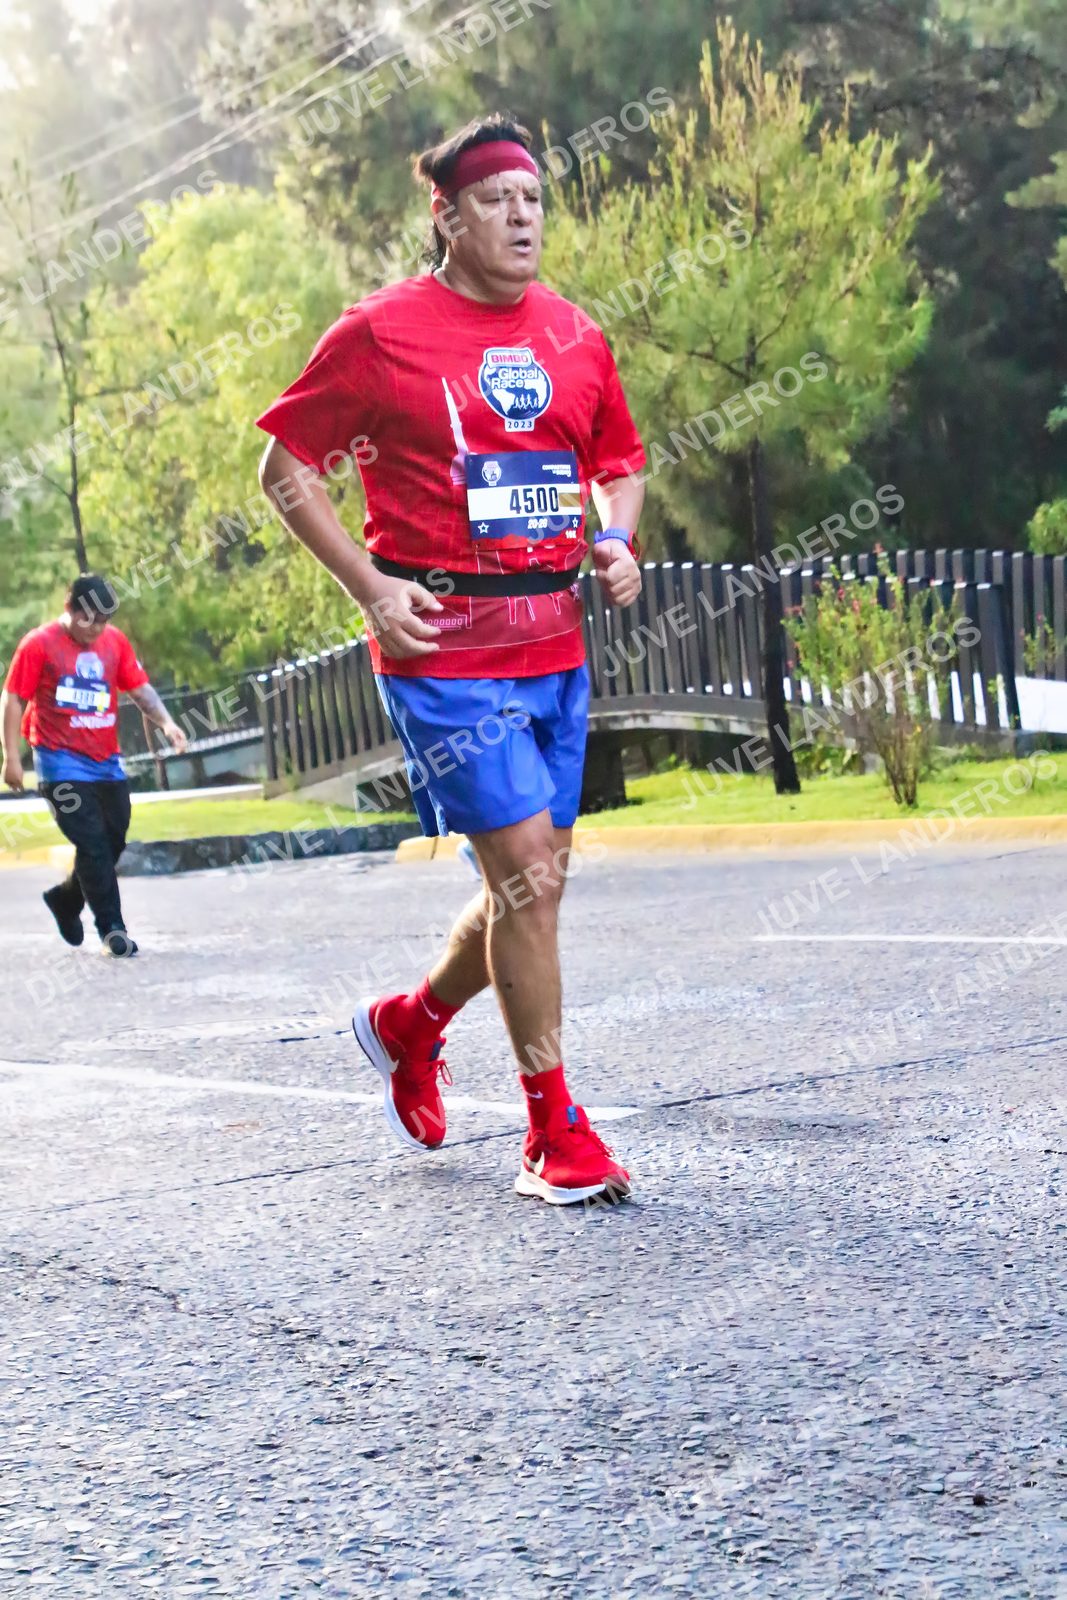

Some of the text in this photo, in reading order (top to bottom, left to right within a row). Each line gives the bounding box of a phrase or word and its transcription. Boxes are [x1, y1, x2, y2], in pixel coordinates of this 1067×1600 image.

[491, 354, 529, 363] BIMBO
[498, 368, 538, 380] Global
[491, 378, 525, 389] Race
[507, 421, 533, 429] 2023
[509, 487, 559, 514] 4500
